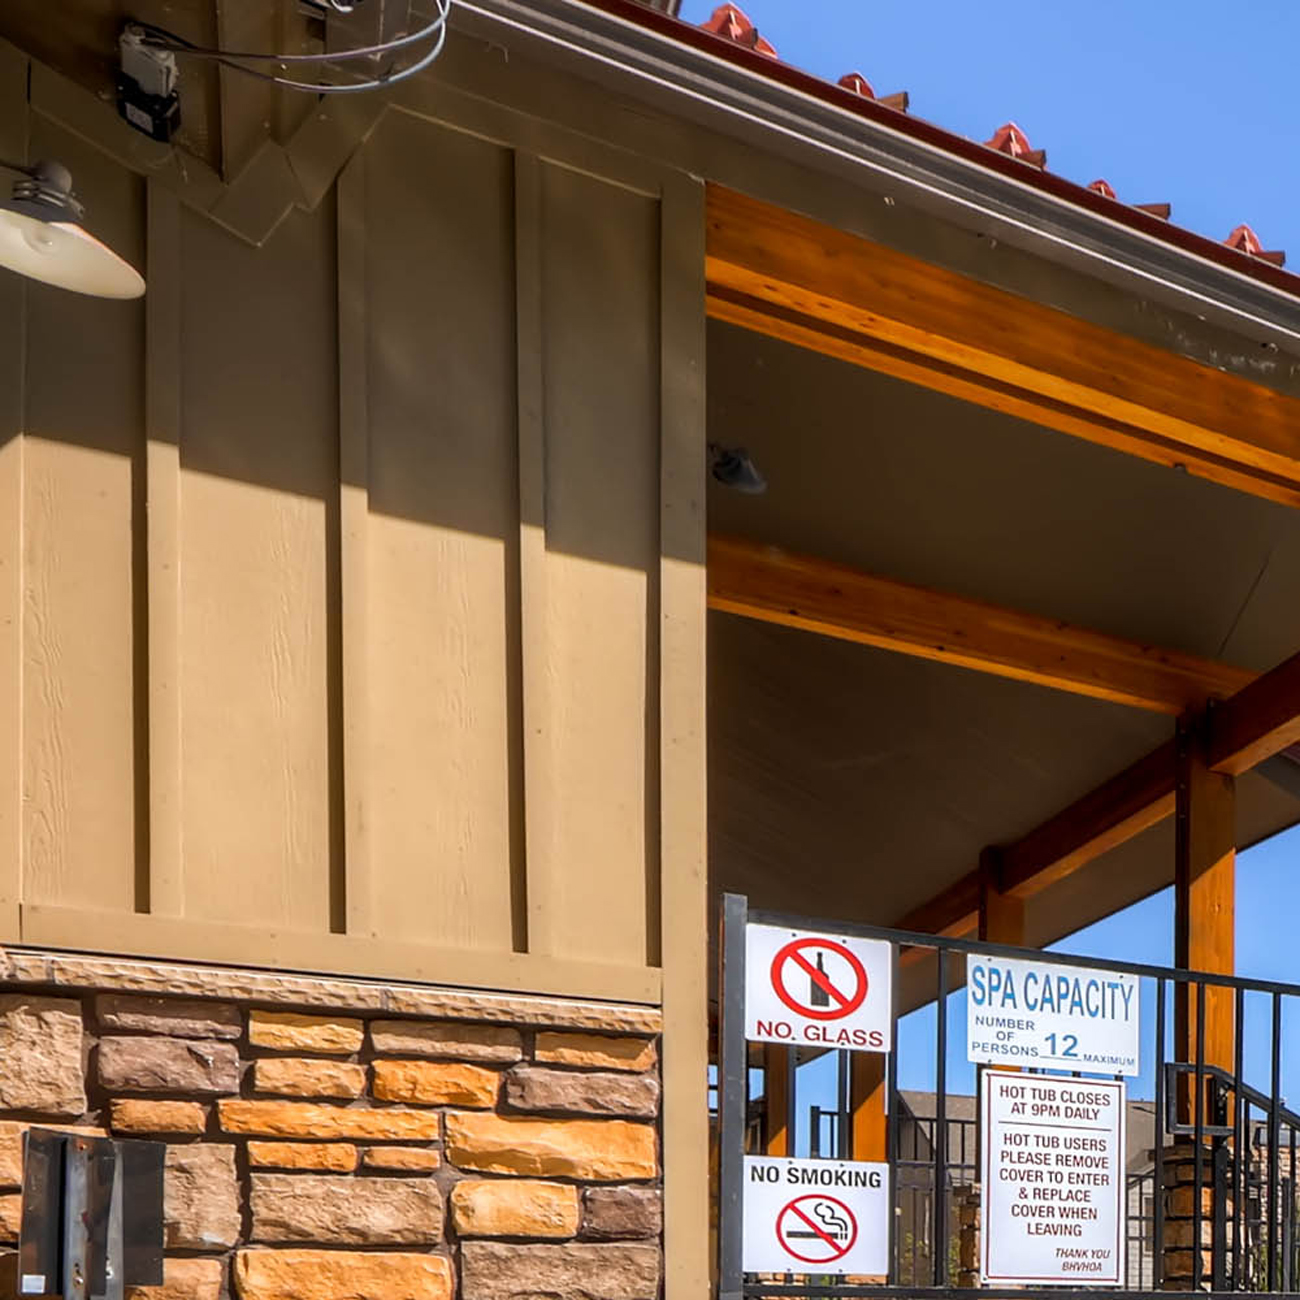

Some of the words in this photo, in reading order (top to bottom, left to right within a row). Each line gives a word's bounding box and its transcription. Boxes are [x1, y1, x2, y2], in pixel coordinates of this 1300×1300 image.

[972, 965, 1017, 1009] SPA
[1024, 972, 1134, 1021] CAPACITY
[975, 1015, 1035, 1031] NUMBER
[756, 1019, 792, 1039] NO
[803, 1024, 884, 1047] GLASS
[996, 1031, 1015, 1042] OF
[972, 1041, 1039, 1057] PERSONS
[1044, 1033, 1079, 1057] 12
[1083, 1054, 1134, 1066] MAXIMUM
[1000, 1085, 1027, 1099] HOT
[1030, 1088, 1057, 1101] TUB
[1060, 1090, 1111, 1106] CLOSES
[1011, 1102, 1027, 1115] AT
[1031, 1103, 1060, 1117] 9PM
[1064, 1106, 1100, 1120] DAILY
[1003, 1133, 1030, 1147] HOT
[1033, 1135, 1060, 1149] TUB
[1064, 1137, 1107, 1152] USERS
[1000, 1150, 1051, 1166] PLEASE
[1055, 1154, 1110, 1169] REMOVE
[750, 1165, 780, 1183] NO
[787, 1167, 882, 1188] SMOKING
[1000, 1168, 1044, 1183] COVER
[1047, 1171, 1064, 1184] TO
[1068, 1171, 1110, 1186] ENTER
[1018, 1187, 1028, 1200] &
[1033, 1187, 1092, 1202] REPLACE
[1011, 1204, 1055, 1218] COVER
[1059, 1206, 1098, 1220] WHEN
[1027, 1223, 1082, 1237] LEAVING
[1055, 1248, 1088, 1259] THANK
[1091, 1249, 1111, 1260] YOU
